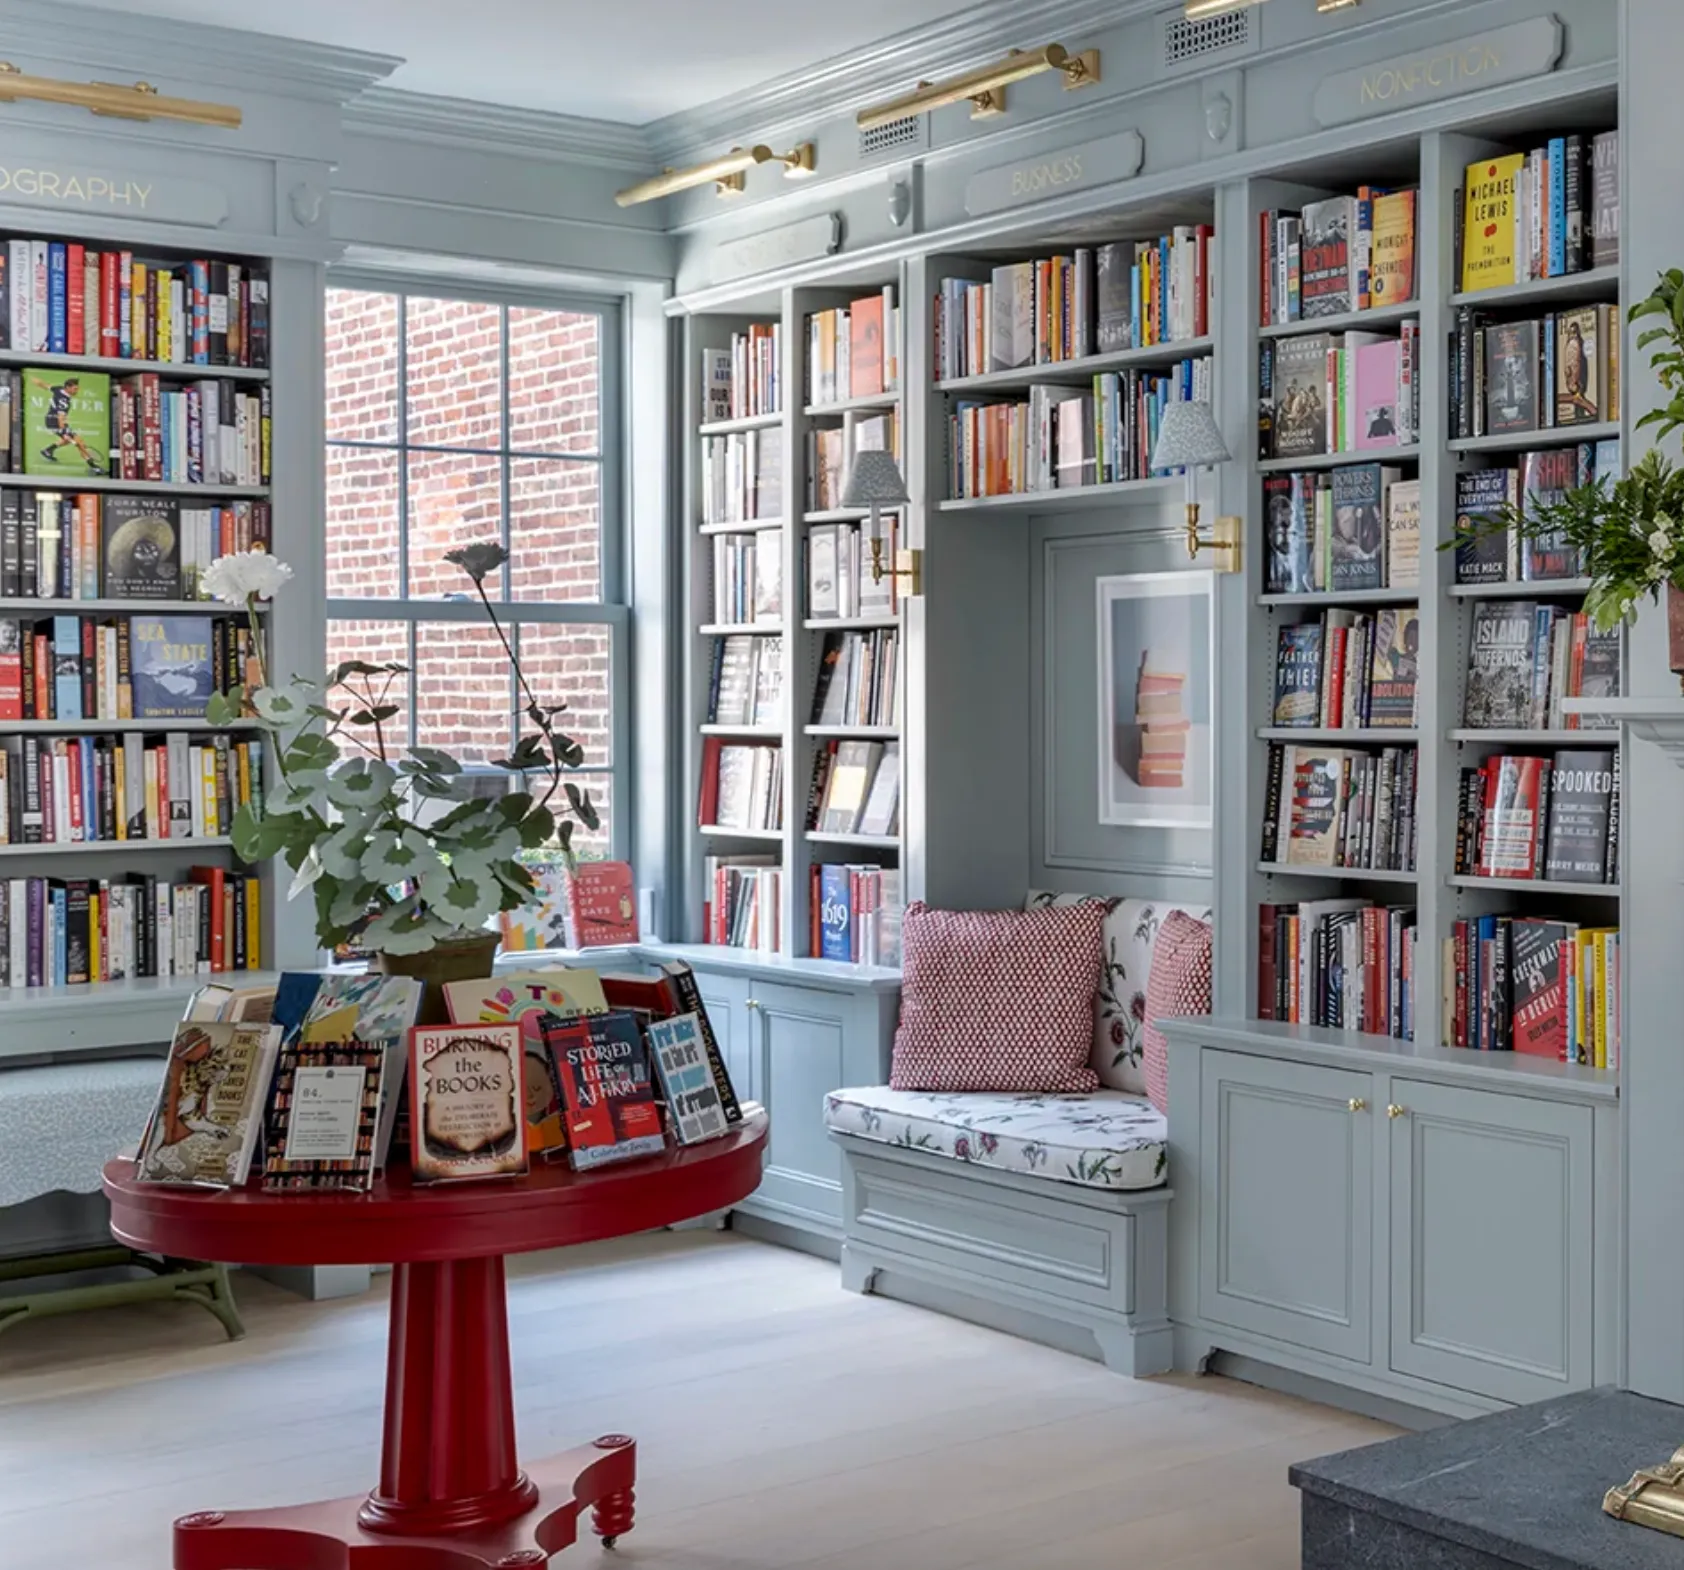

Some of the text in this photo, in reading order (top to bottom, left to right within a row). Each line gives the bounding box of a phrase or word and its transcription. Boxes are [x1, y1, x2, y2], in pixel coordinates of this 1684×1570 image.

[1360, 46, 1499, 105] NONFICTION
[1012, 154, 1082, 196] BUSINESS
[1469, 176, 1515, 203] MICHAEL
[1474, 200, 1509, 223] LEWIS
[31, 395, 104, 412] MASTER
[1460, 481, 1474, 492] THE
[142, 500, 177, 510] NEALE
[1459, 562, 1503, 574] KATIE MACK
[136, 623, 166, 642] SEA
[1476, 618, 1530, 644] ISLAND
[163, 644, 207, 661] STATE
[1473, 651, 1528, 667] INFERNOS
[1278, 667, 1318, 686] THIEF
[1551, 769, 1612, 793] SPOOKED
[1608, 798, 1619, 844] LUCKY
[579, 886, 617, 896] LIGHT
[821, 897, 848, 932] 1619
[1496, 927, 1505, 965] TUNNEL
[423, 1033, 512, 1053] BURNING
[588, 1034, 607, 1043] THE
[234, 1049, 249, 1058] CAT
[455, 1057, 482, 1073] the
[436, 1074, 502, 1094] BOOKS
[708, 1054, 732, 1102] EATERS
